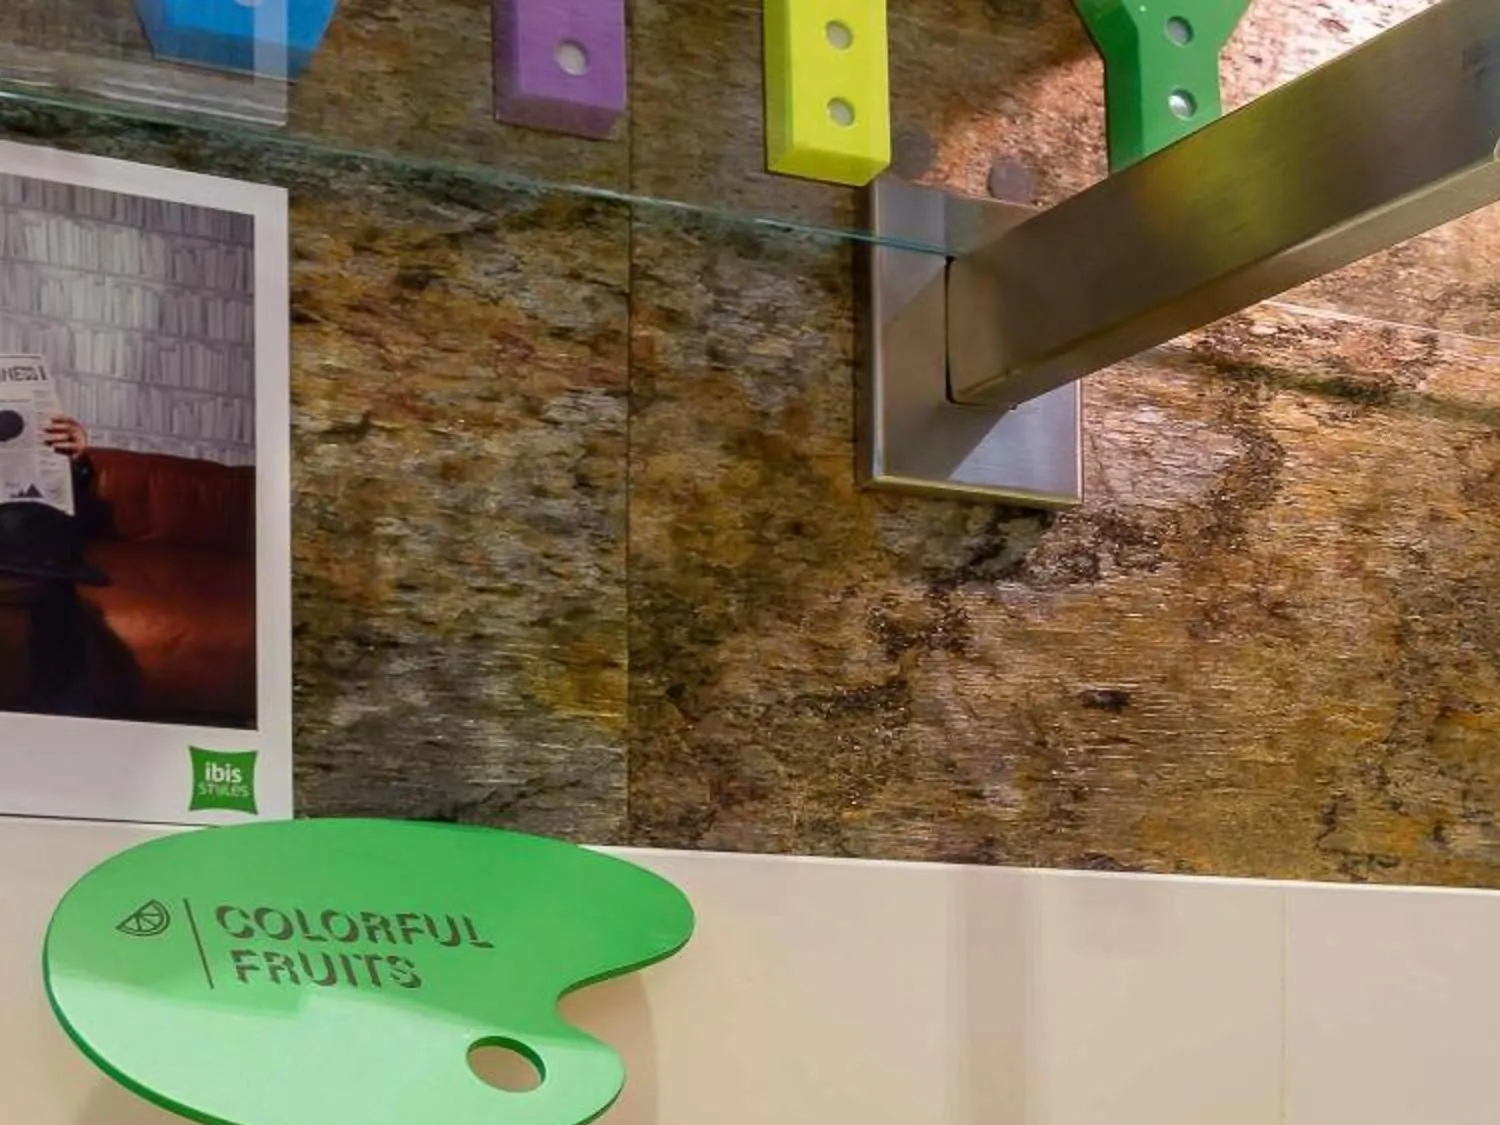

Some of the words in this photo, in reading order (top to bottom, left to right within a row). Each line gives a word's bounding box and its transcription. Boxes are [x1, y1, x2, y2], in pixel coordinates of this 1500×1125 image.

[205, 760, 243, 783] ibis
[215, 904, 495, 950] COLORFUL
[230, 948, 423, 990] FRUITS
